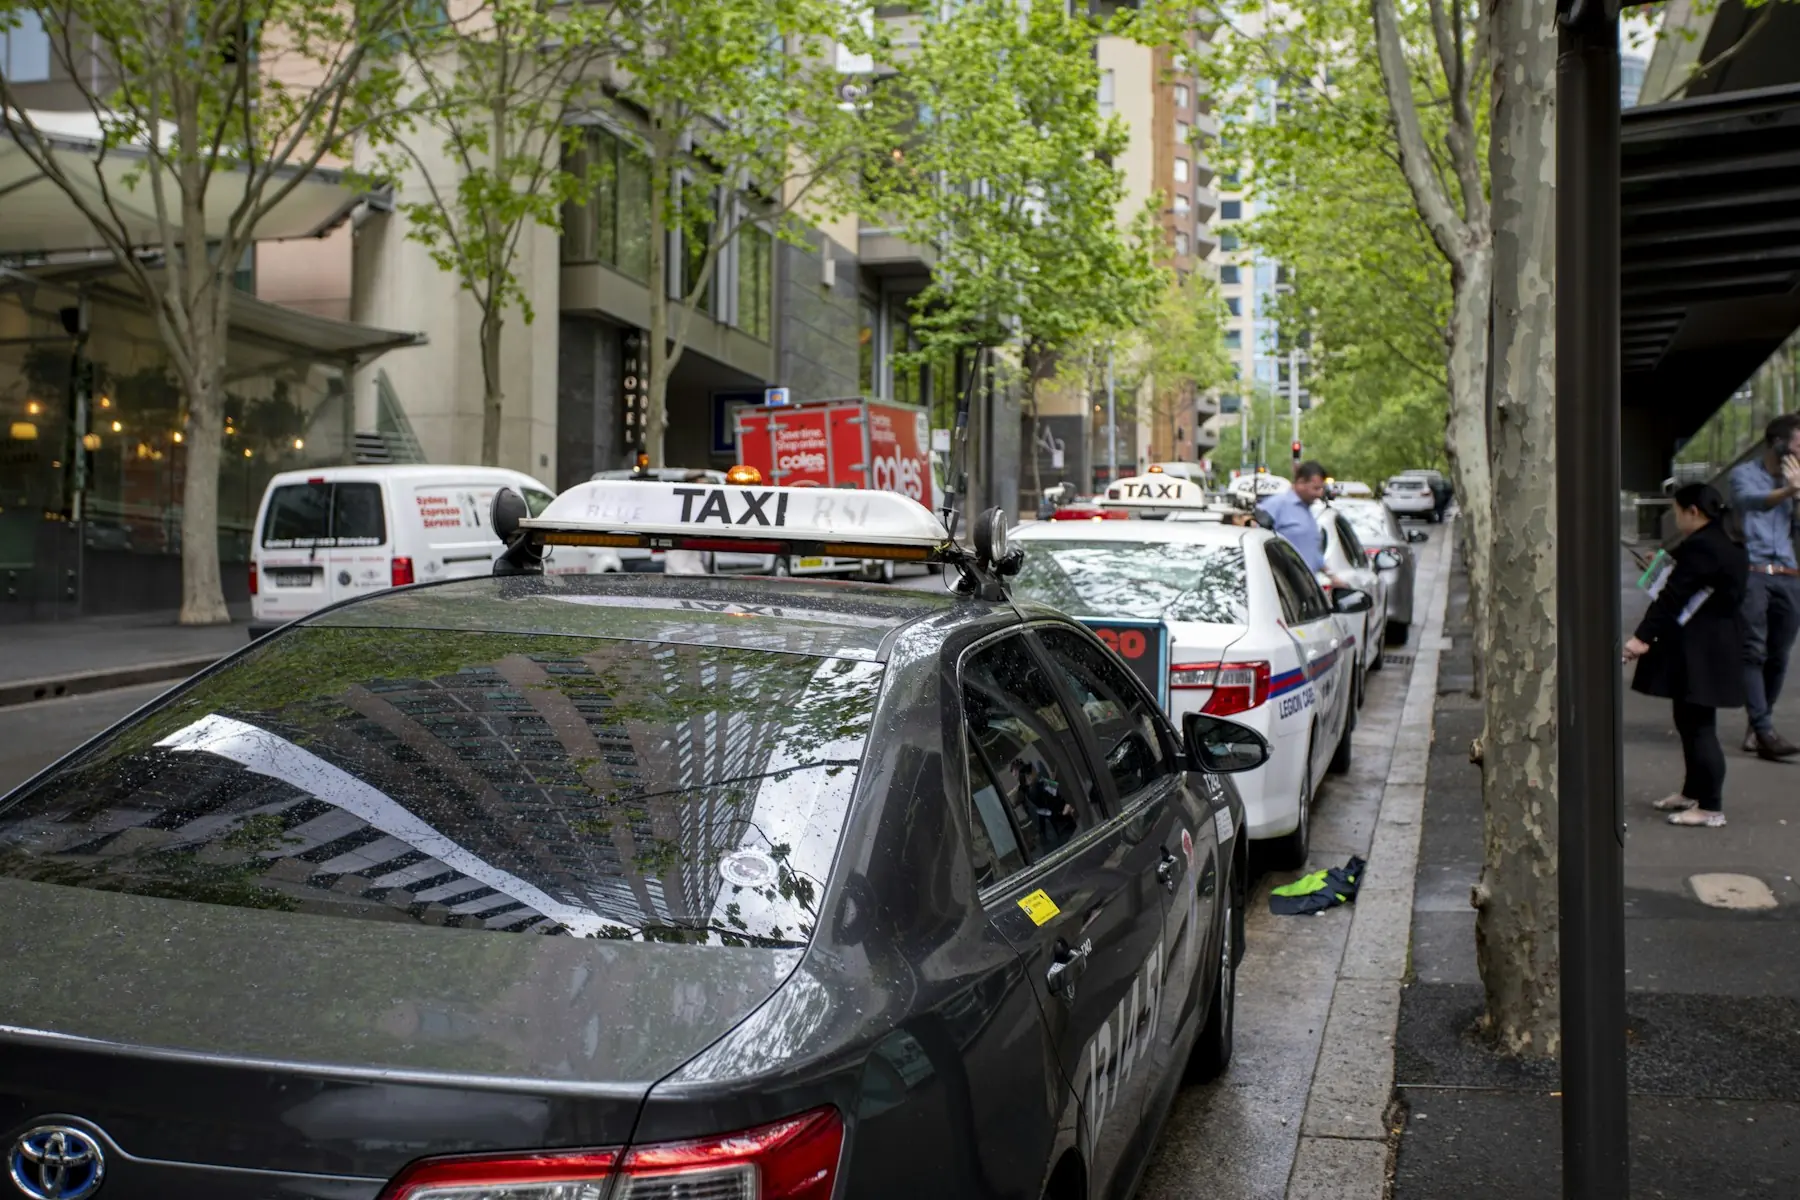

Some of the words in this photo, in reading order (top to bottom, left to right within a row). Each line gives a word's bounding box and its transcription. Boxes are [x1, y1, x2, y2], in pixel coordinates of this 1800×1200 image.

[624, 358, 638, 443] HOTEL
[779, 451, 825, 470] coles
[873, 443, 923, 500] coles
[416, 496, 448, 506] Sydney
[1124, 484, 1182, 498] TAXI
[673, 488, 789, 526] TAXI
[424, 519, 461, 528] Services
[1279, 694, 1303, 719] LEGION
